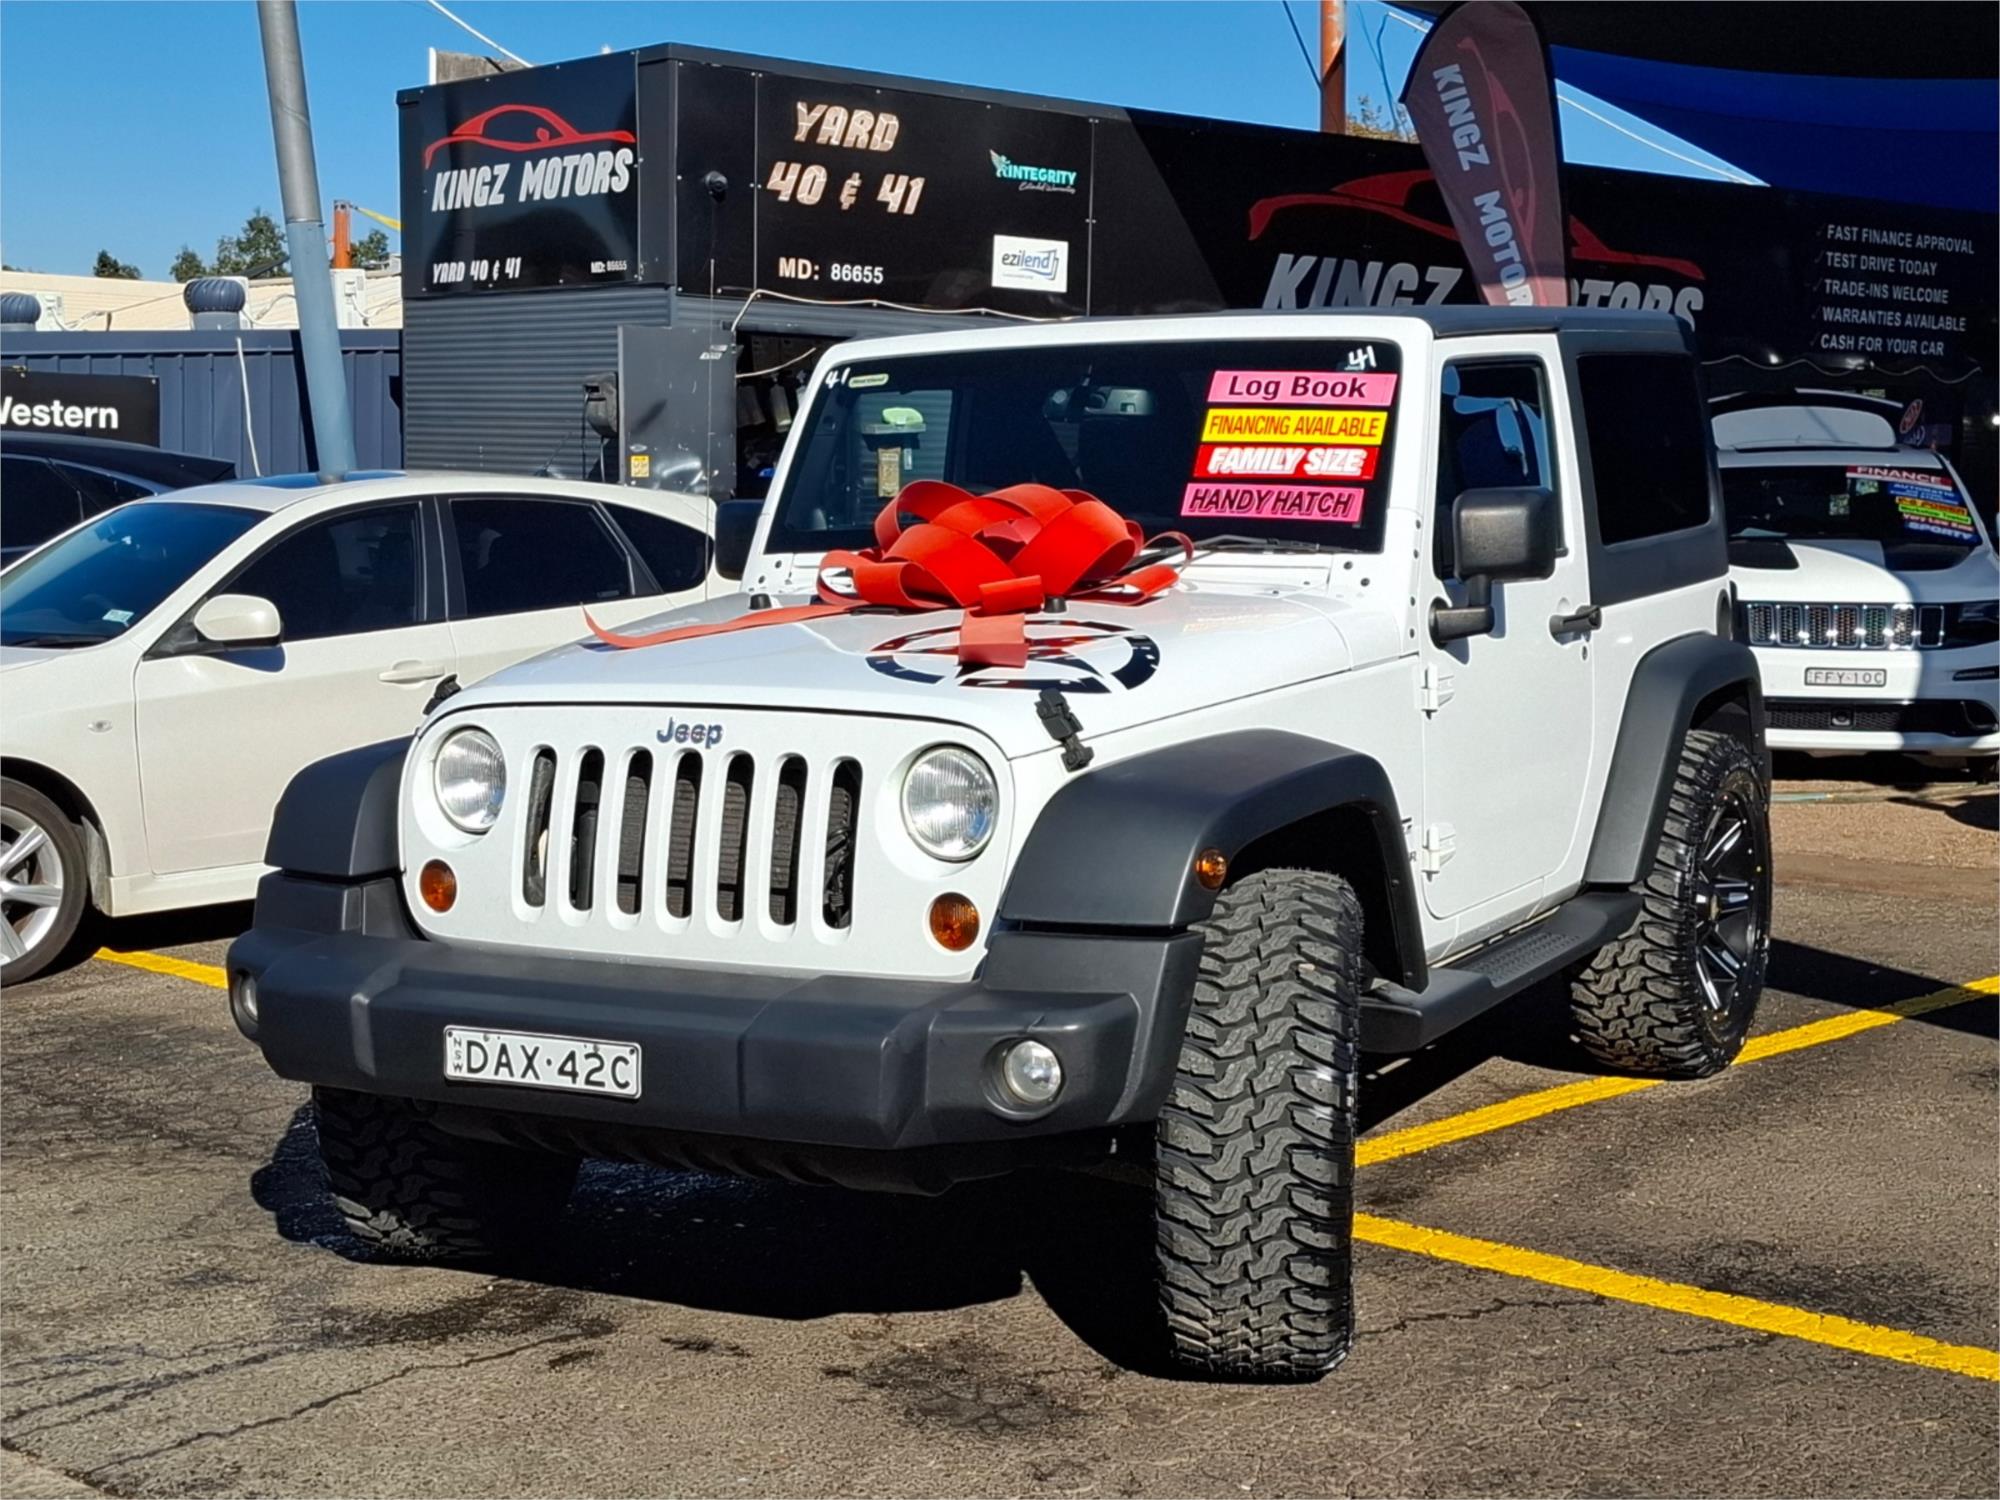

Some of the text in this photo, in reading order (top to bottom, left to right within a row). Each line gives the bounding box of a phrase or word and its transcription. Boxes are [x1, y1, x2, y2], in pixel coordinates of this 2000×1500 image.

[793, 101, 899, 152] YARD
[431, 148, 634, 212] KINGZ MOTORS
[766, 161, 925, 215] 40 & 41
[1433, 63, 1534, 307] KINGZ MOTOR
[1827, 224, 1975, 254] FAST FINANCE APPROVAL
[433, 261, 466, 284] YARD
[469, 260, 489, 281] 40
[505, 257, 522, 279] 41
[778, 256, 884, 284] MD: 86655
[1002, 249, 1053, 270] ezilend
[1826, 252, 1938, 276] TEST DRIVE TODAY
[1261, 253, 1463, 309] KINGZ
[1824, 279, 1949, 304] TRADE-INS WELCOME
[1822, 306, 1967, 332] WARRANTIES AVAILABLE
[1348, 345, 1377, 370] 41
[1821, 333, 1944, 356] CASH FOR YOUR CAR
[825, 367, 851, 389] 41
[1228, 375, 1367, 401] Log Book
[1209, 415, 1380, 437] FINANCING AVAILABLE
[1207, 447, 1368, 476] FAMILY SIZE
[1856, 466, 1942, 484] FINANCE
[1189, 488, 1353, 518] HANDY HATCH
[656, 716, 723, 749] Jeep
